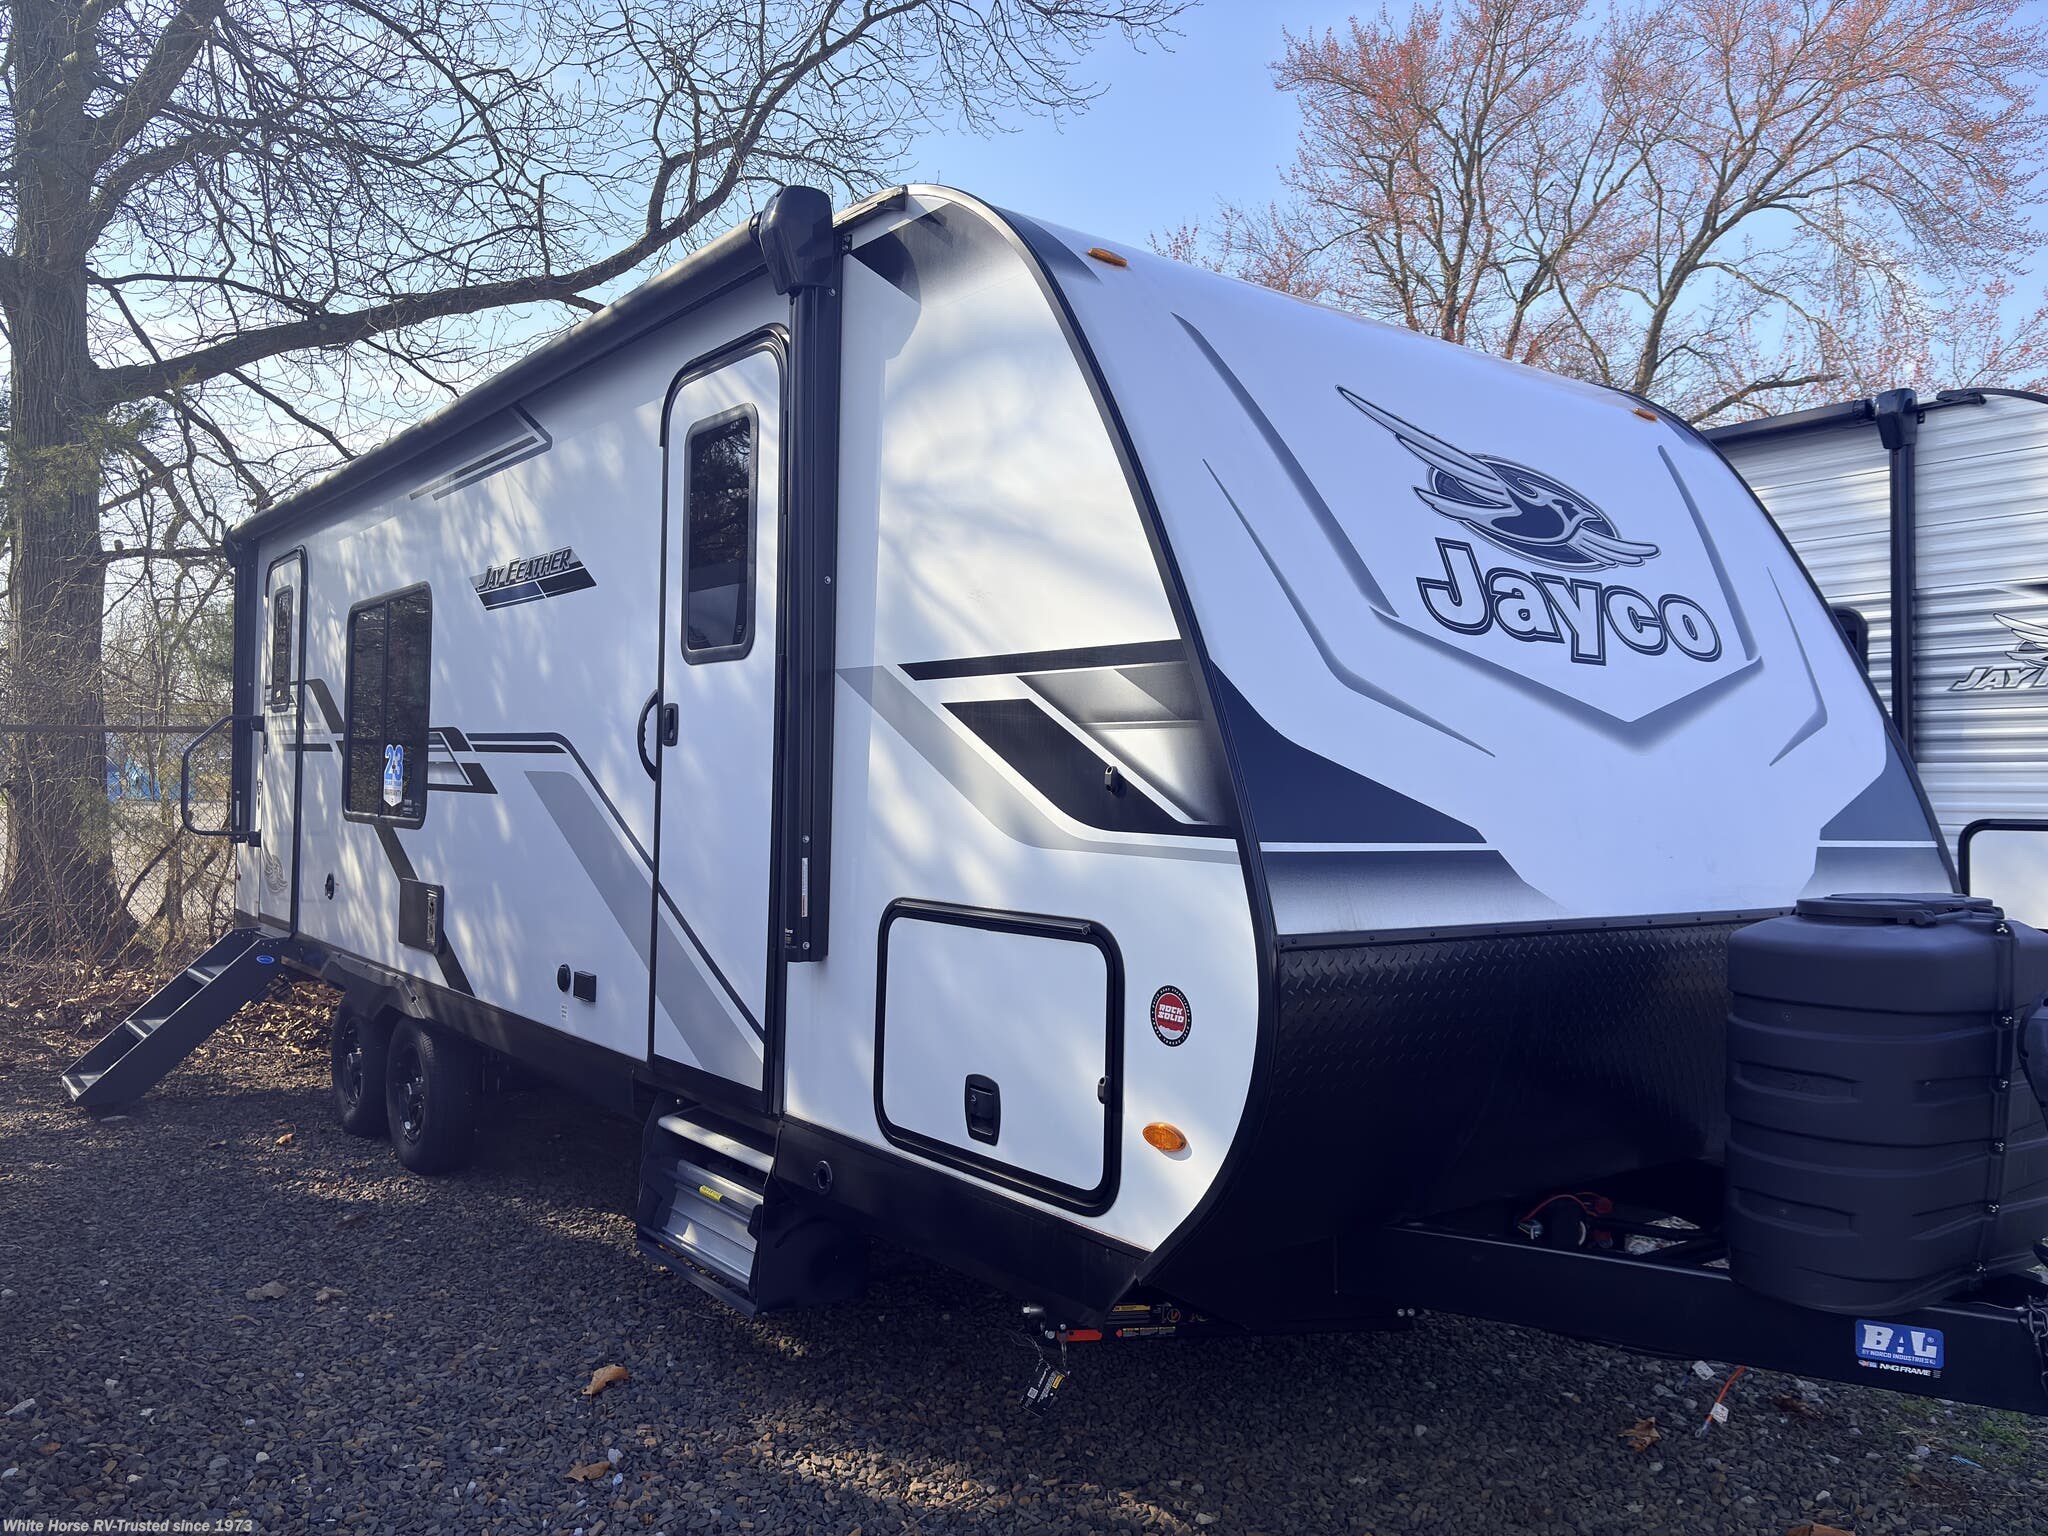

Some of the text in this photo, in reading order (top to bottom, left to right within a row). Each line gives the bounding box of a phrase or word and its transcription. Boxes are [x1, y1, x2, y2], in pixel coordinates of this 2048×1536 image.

[478, 546, 571, 590] JAY FEATHER
[1416, 537, 1722, 666] Jayco
[1159, 1004, 1183, 1015] ROCK
[1157, 1011, 1184, 1023] SOLID
[1900, 1366, 1931, 1377] FRAME
